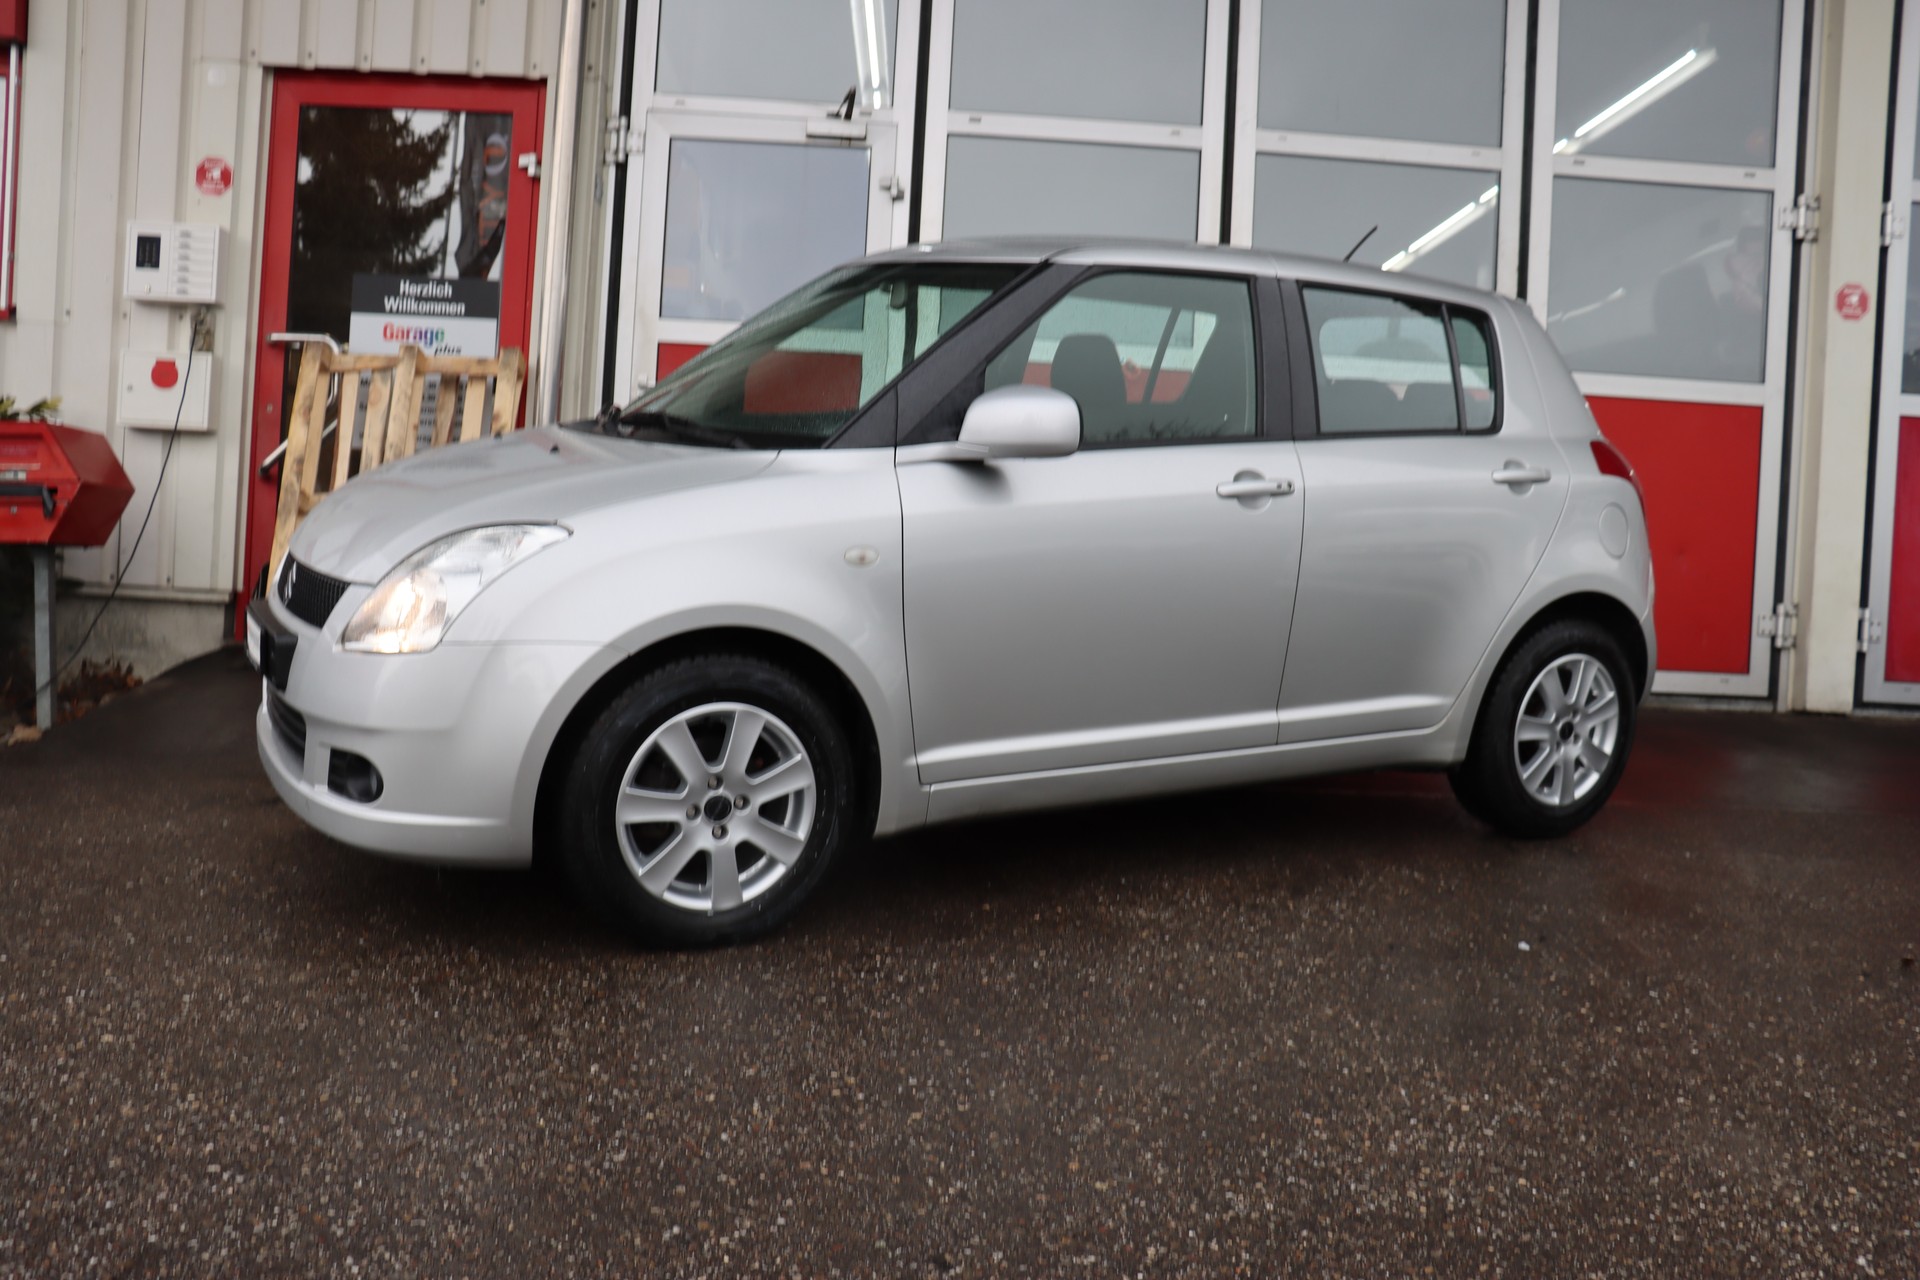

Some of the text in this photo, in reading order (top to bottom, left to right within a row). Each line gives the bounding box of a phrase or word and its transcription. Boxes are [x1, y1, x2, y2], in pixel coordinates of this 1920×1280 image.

[400, 279, 452, 299] Herzlich
[384, 295, 465, 316] Willkommen
[382, 321, 445, 348] Garage
[434, 345, 462, 357] plus
